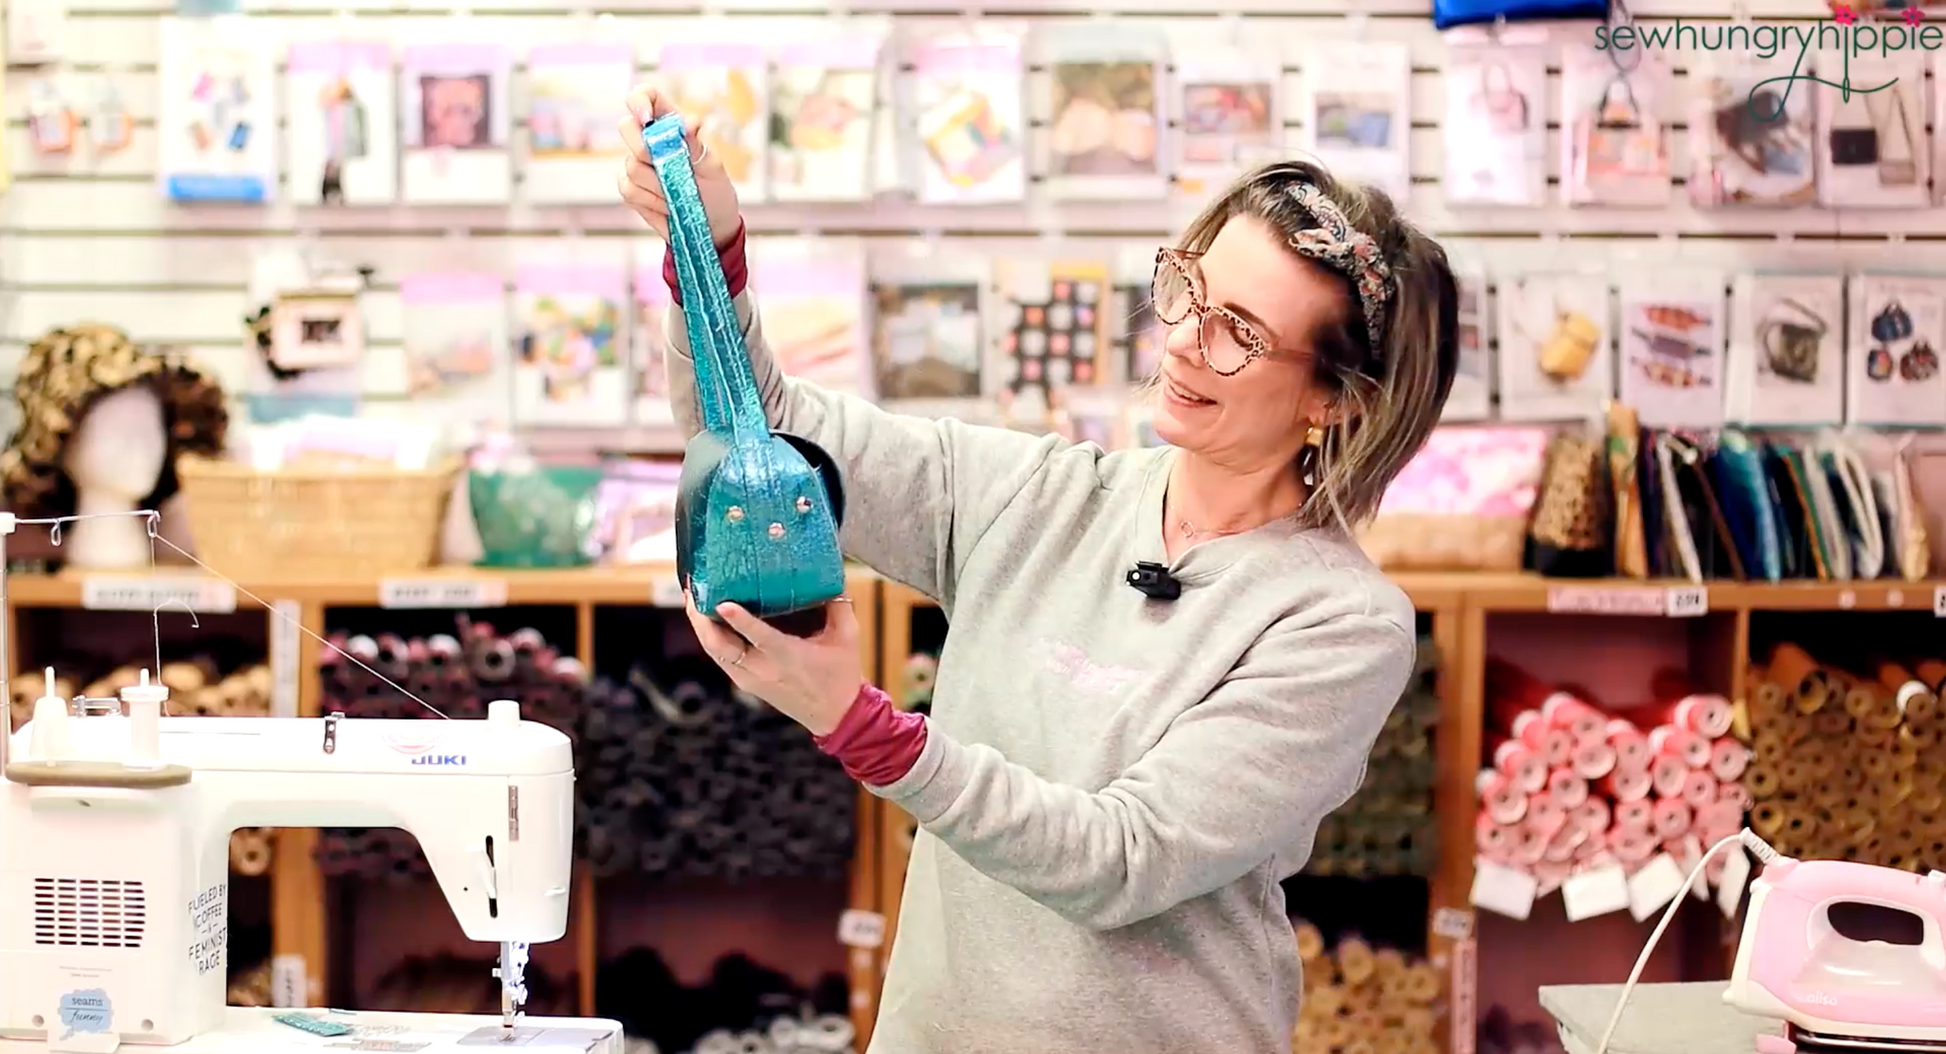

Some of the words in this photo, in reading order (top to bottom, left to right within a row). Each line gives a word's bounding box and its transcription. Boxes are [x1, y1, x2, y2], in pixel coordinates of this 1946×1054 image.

[411, 755, 467, 766] JUKI
[188, 886, 218, 914] FUELED
[195, 902, 222, 928] COFFEE
[188, 927, 227, 961] FEMINIST
[199, 950, 221, 975] RAGE
[72, 997, 104, 1006] seams
[69, 1009, 103, 1025] funny
